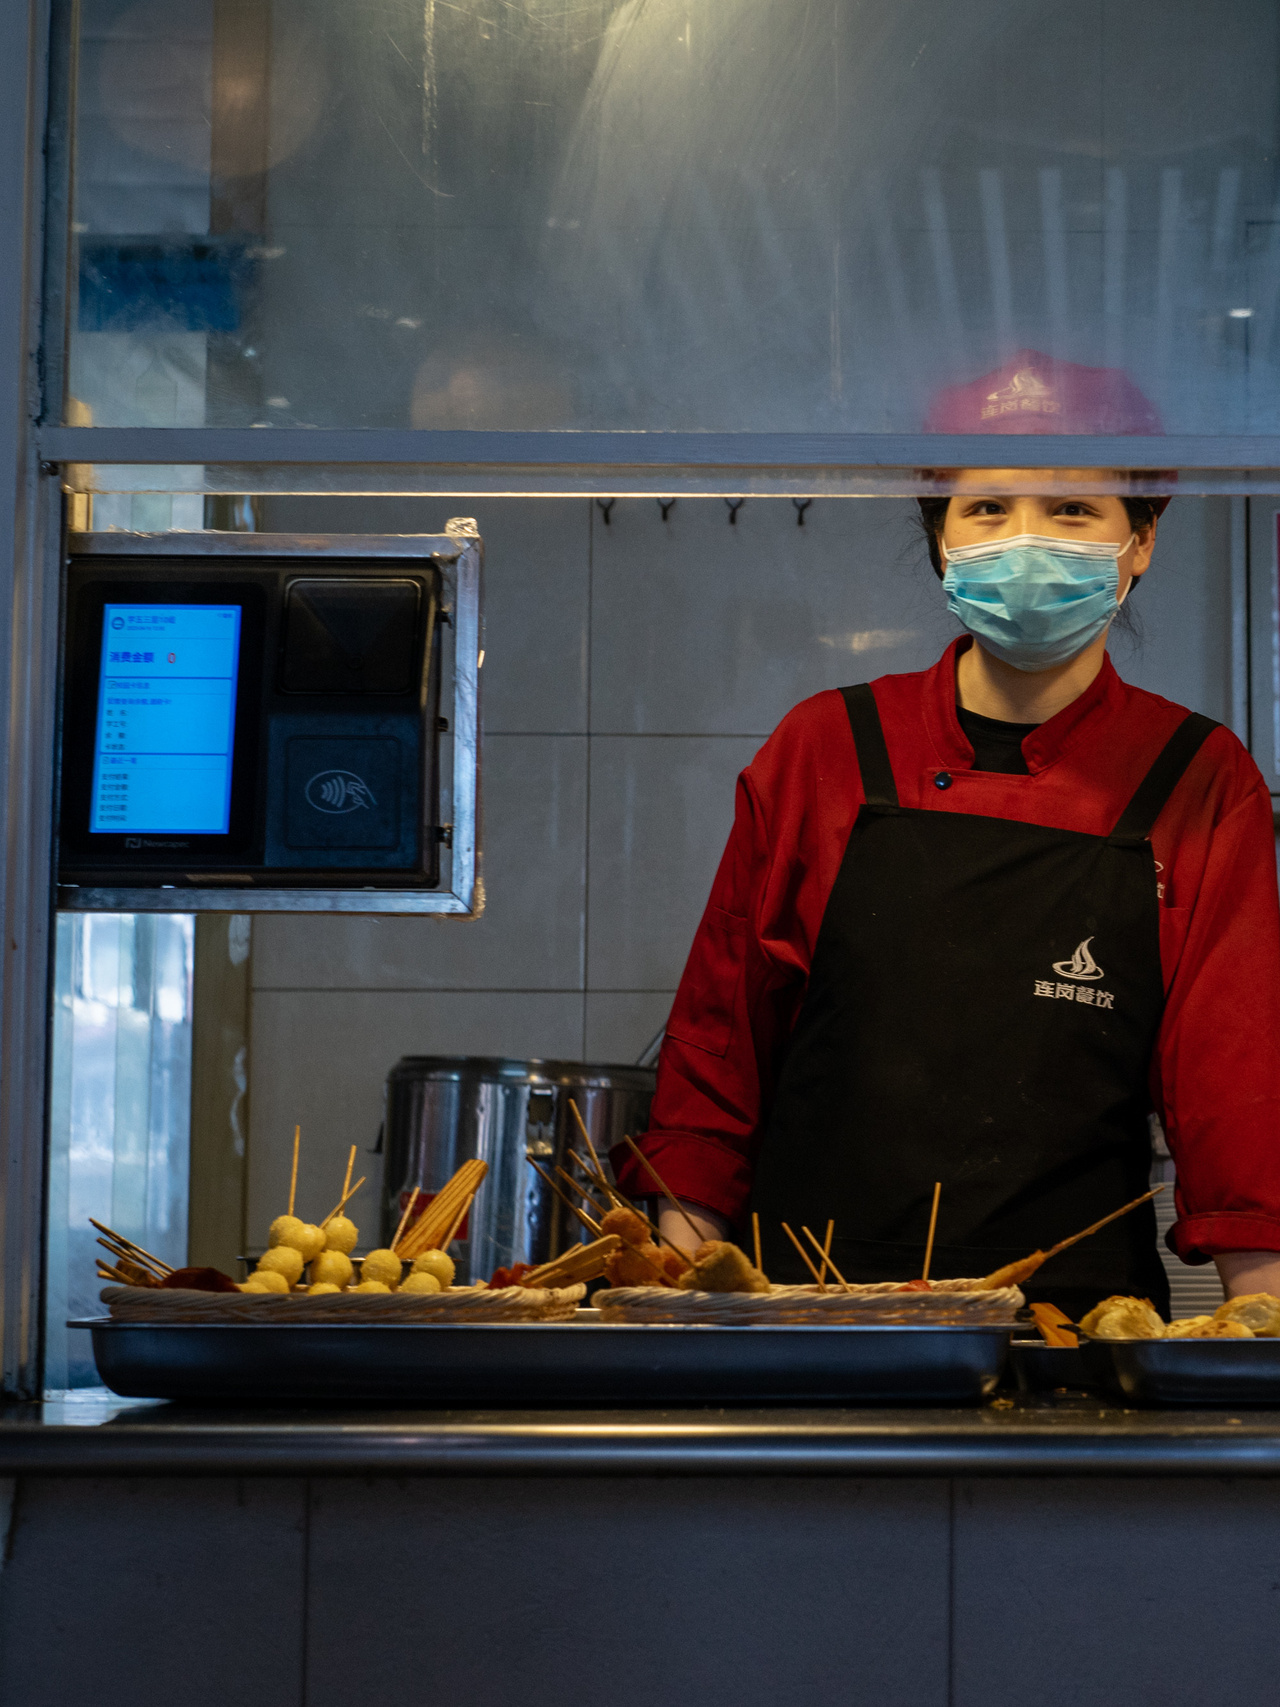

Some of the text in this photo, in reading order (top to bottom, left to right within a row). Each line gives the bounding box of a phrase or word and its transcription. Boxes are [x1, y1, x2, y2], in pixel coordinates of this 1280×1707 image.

[109, 651, 177, 664] 消费金额 0
[1033, 979, 1115, 1010] 连岗餐饮
